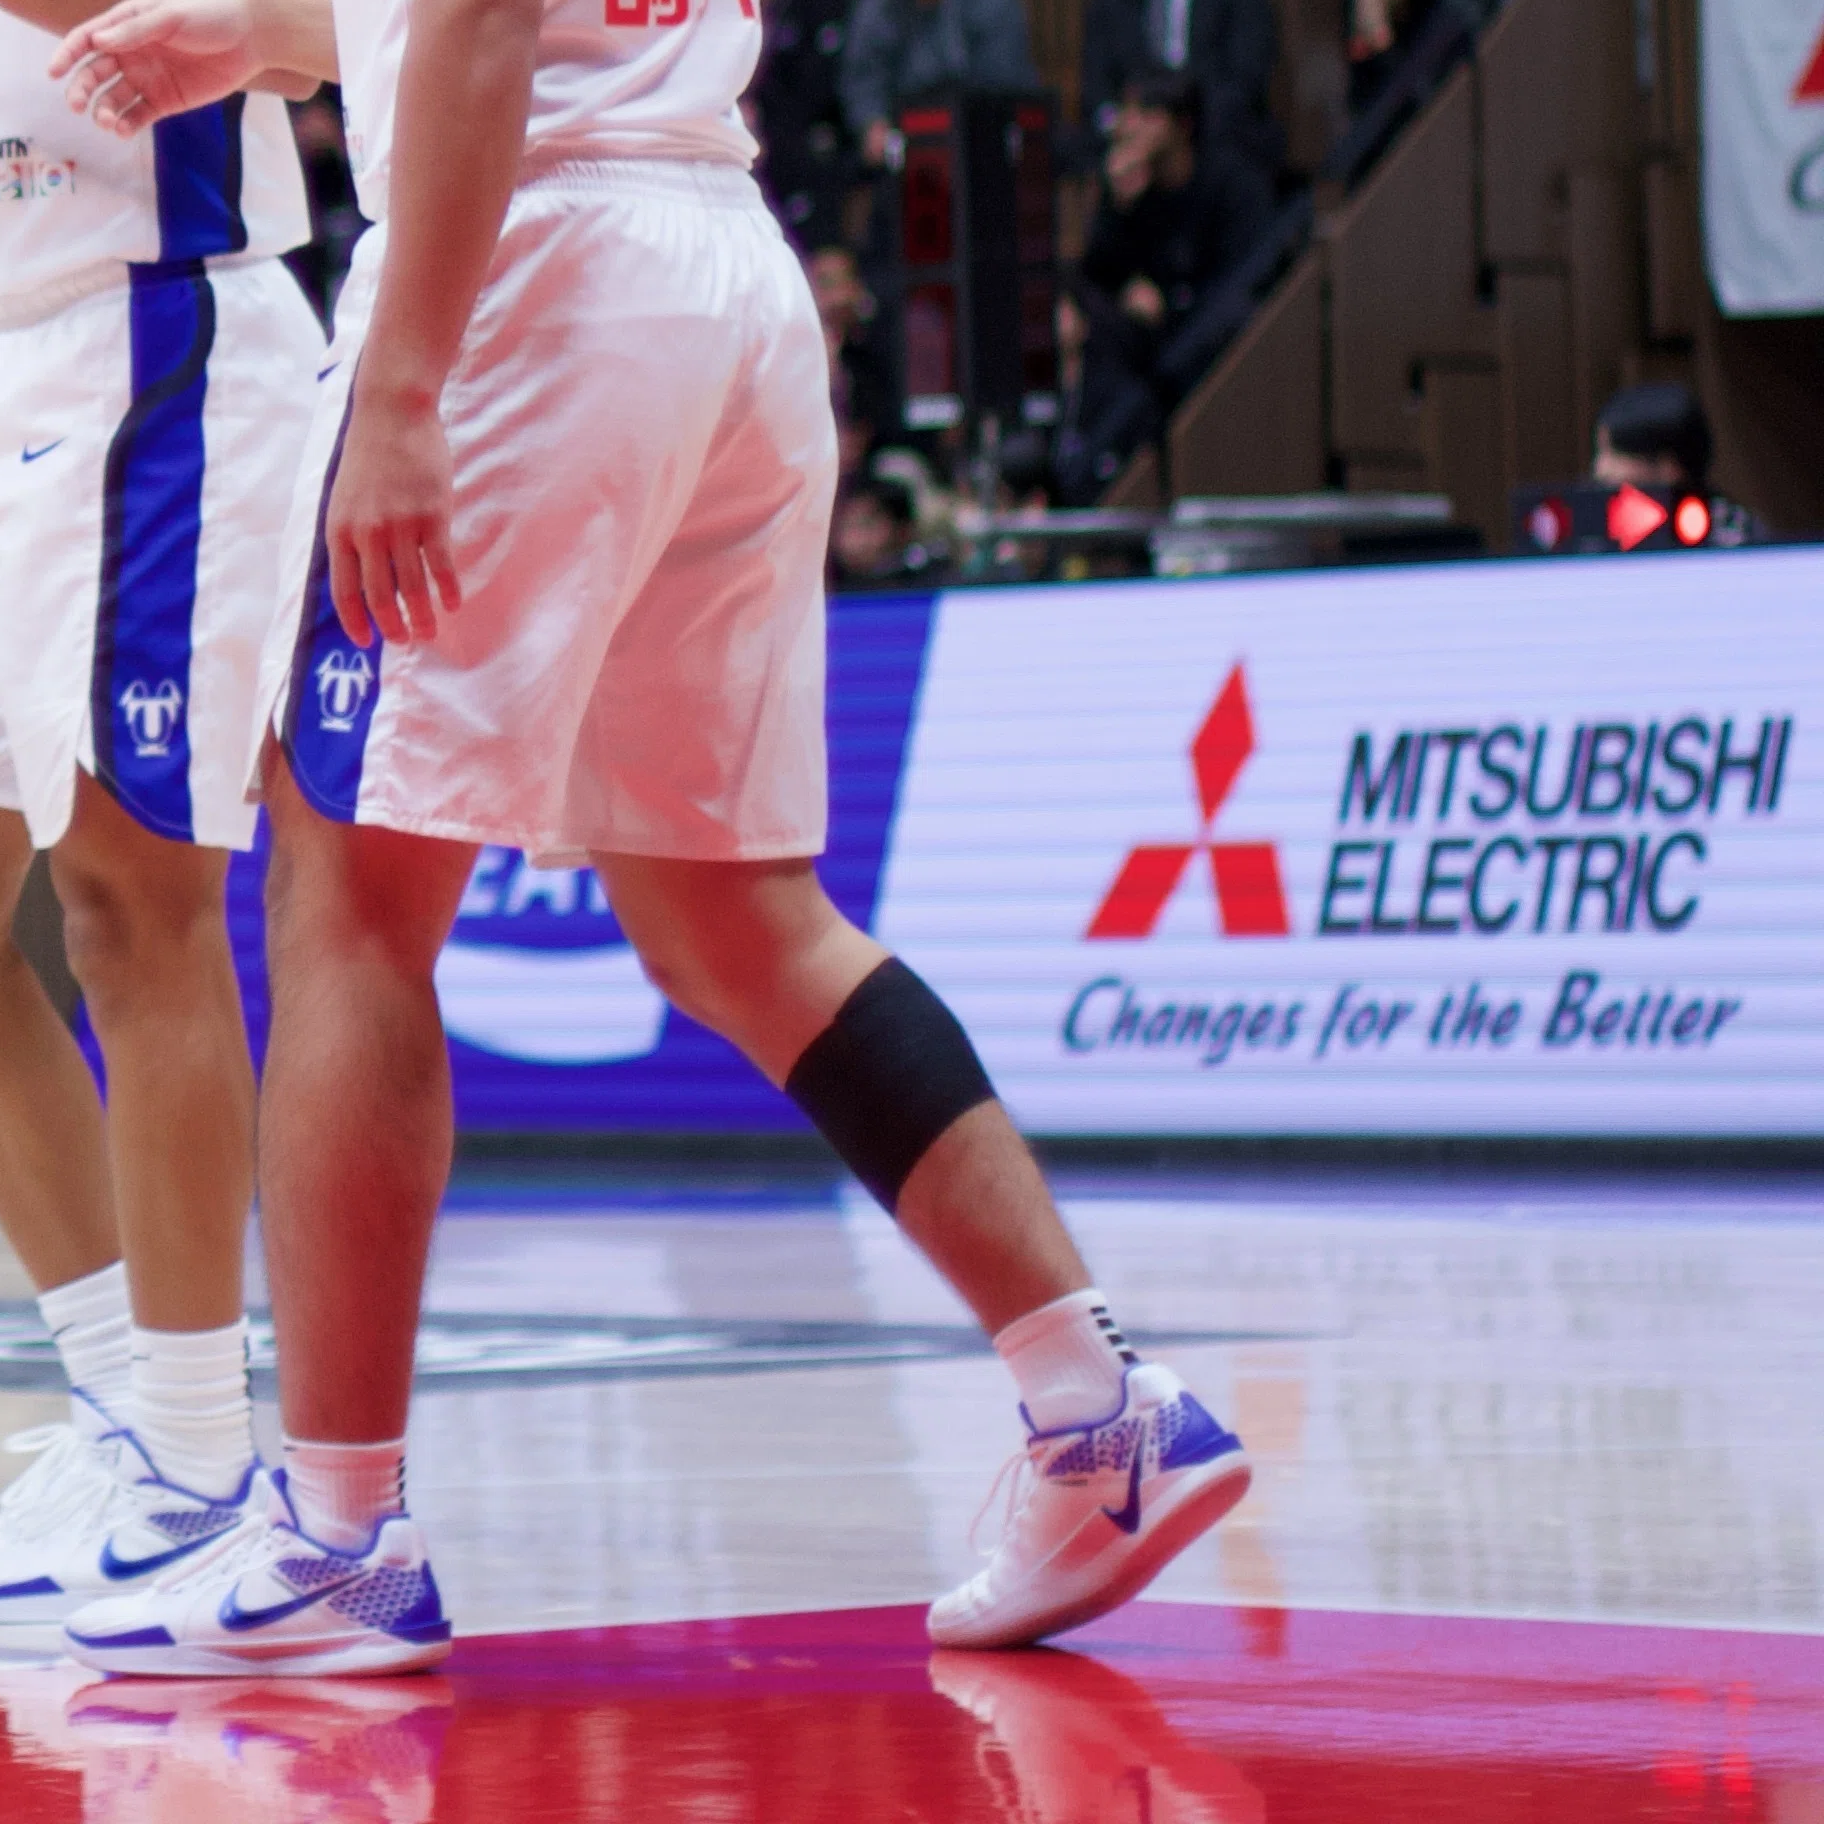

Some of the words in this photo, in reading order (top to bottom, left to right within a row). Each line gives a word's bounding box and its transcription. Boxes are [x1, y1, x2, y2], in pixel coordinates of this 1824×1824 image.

[1337, 714, 1794, 824] MITSUBISHI
[1318, 829, 1708, 936] ELECTRIC
[1061, 975, 1307, 1067] Changes
[1314, 982, 1418, 1060] for
[1428, 978, 1524, 1048] the
[1540, 967, 1742, 1049] Better
